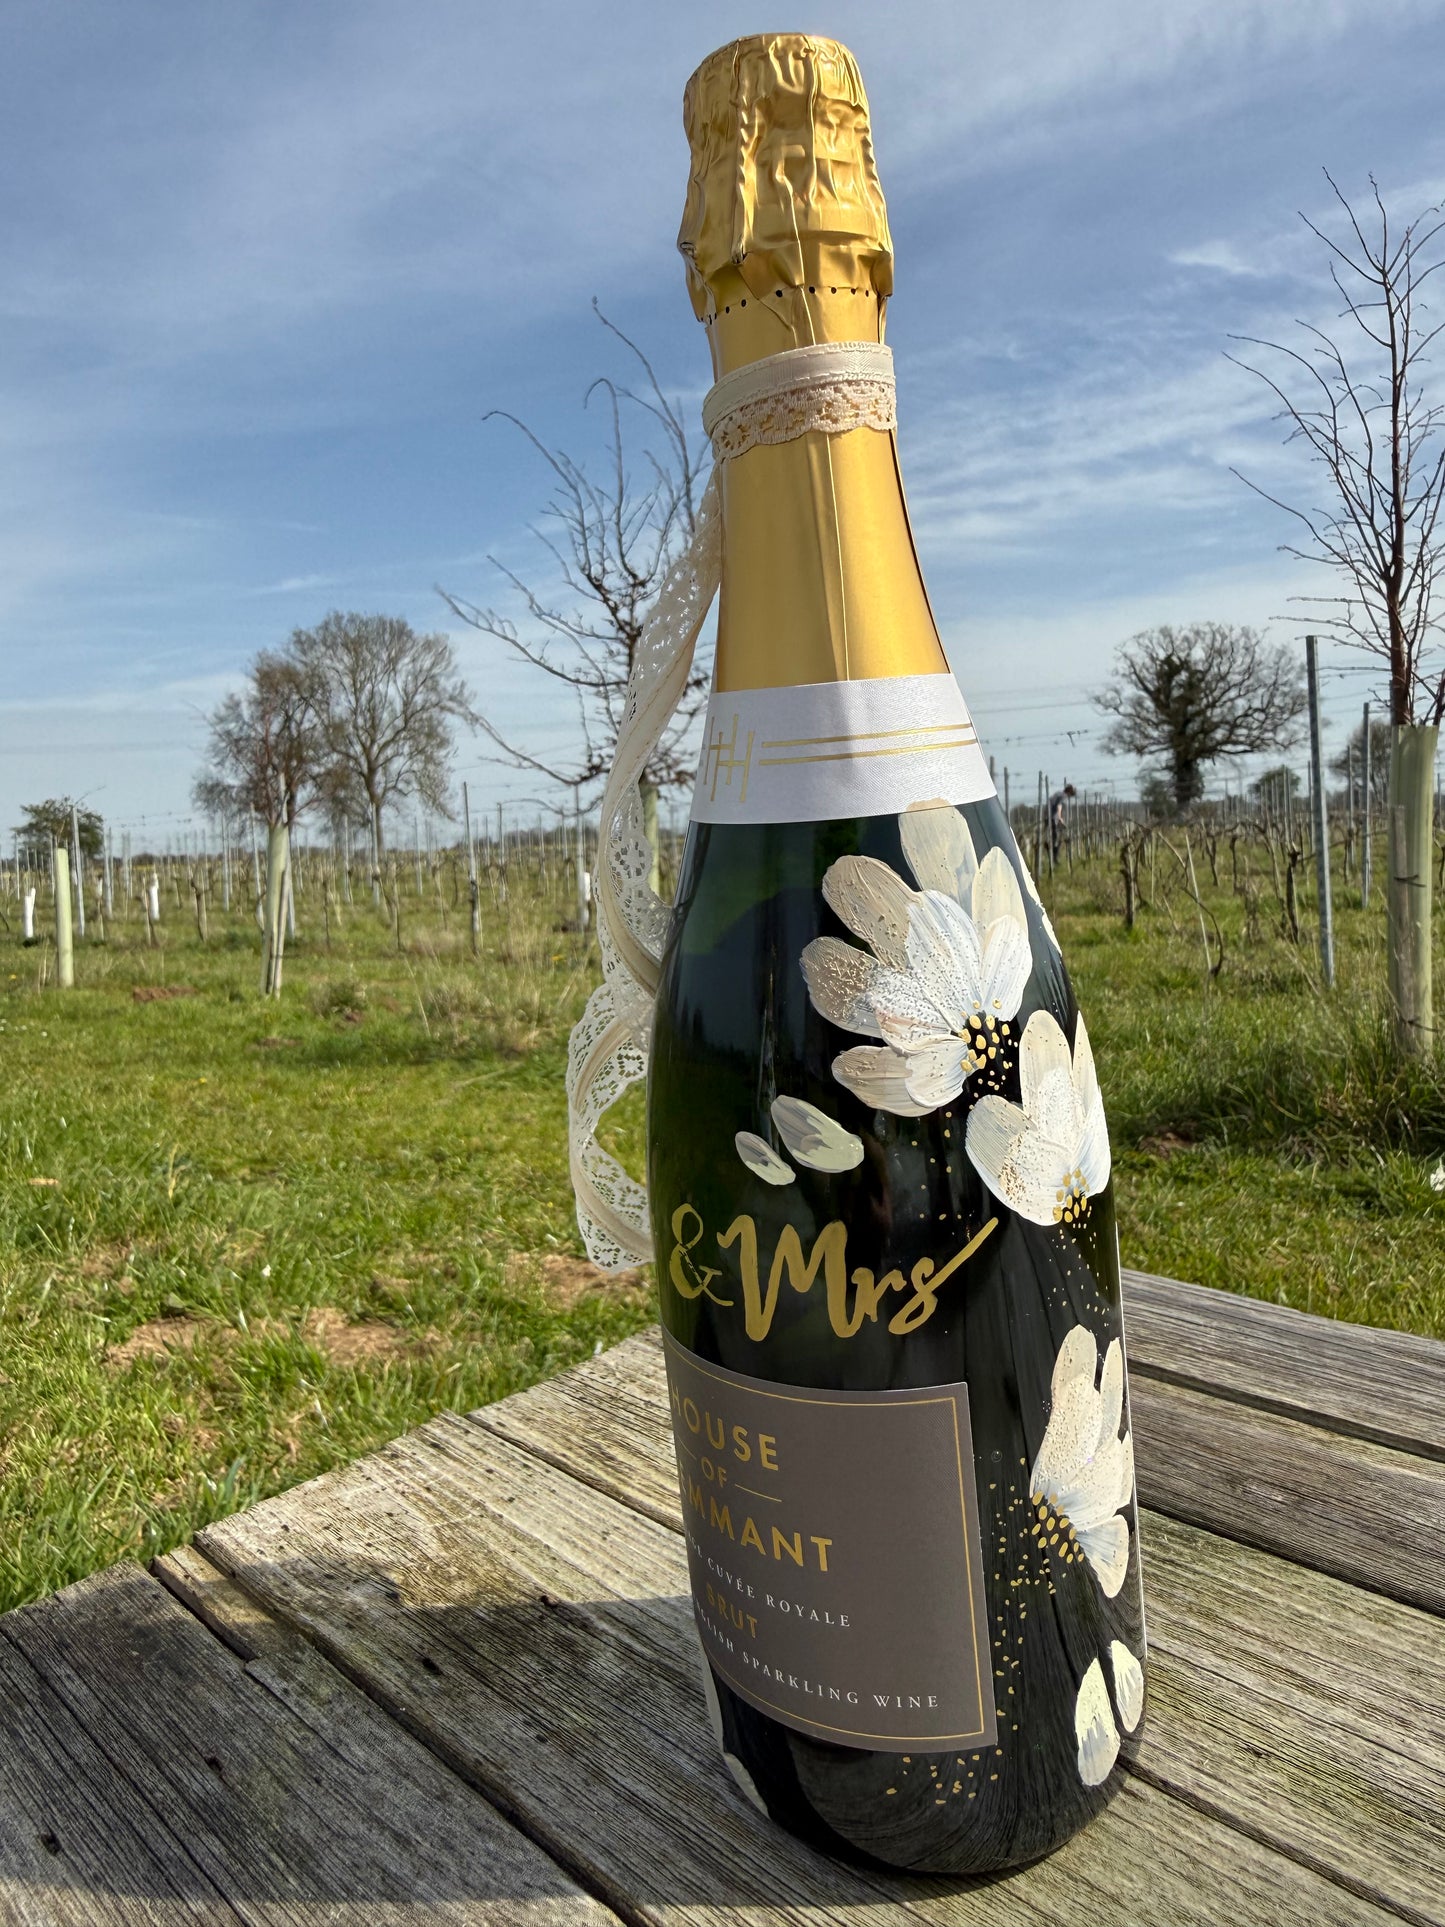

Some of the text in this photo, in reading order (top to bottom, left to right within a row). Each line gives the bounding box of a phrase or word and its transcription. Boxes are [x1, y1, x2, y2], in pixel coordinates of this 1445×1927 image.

[669, 1203, 999, 1342] & Mrs
[671, 1379, 779, 1471] HOUSE
[679, 1461, 832, 1572] EMMANT
[701, 1456, 728, 1489] OF
[705, 1582, 758, 1639] BRUT
[707, 1557, 850, 1628] CUVÉE ROYALE
[694, 1596, 939, 1709] GLISH SPARKLING WINE
